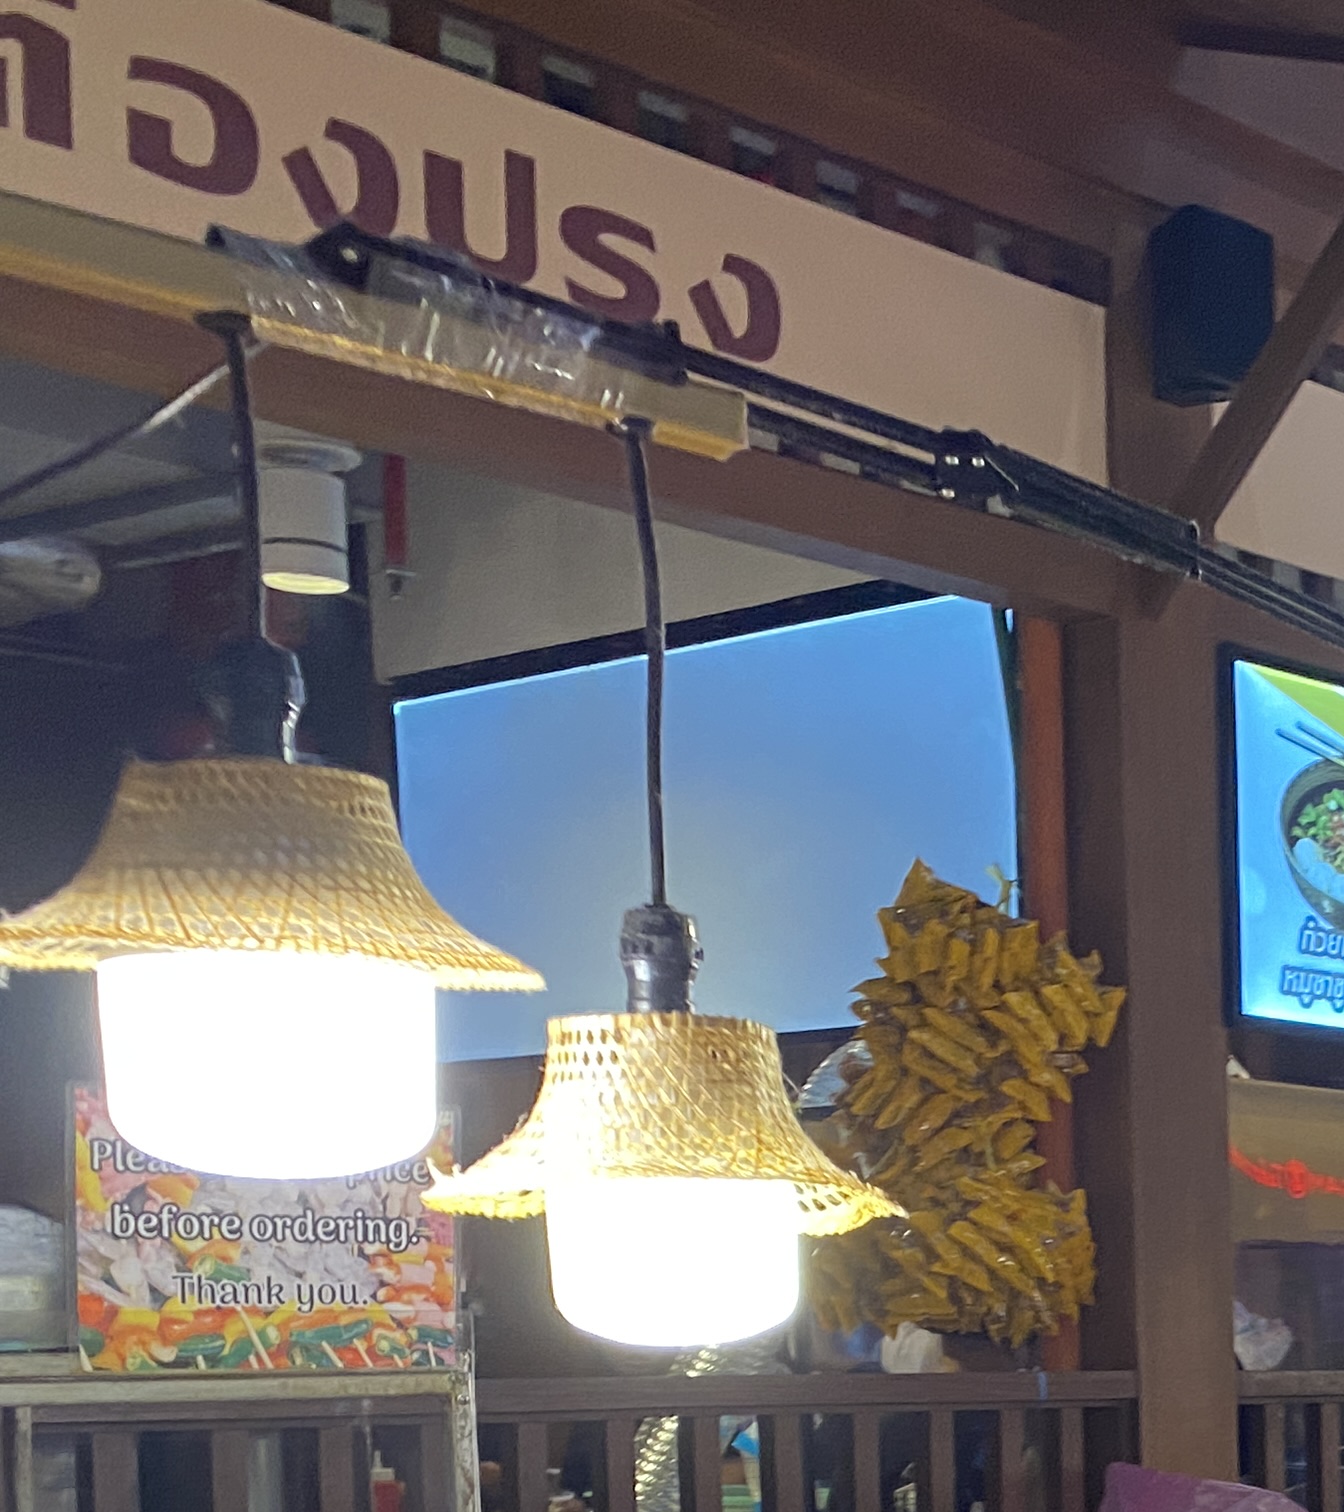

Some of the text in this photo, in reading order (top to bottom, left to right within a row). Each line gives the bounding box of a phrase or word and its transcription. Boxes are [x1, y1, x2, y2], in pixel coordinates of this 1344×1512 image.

[91, 1138, 187, 1173] Plea
[111, 1203, 419, 1251] before ordering.
[172, 1273, 369, 1313] Thank you.
